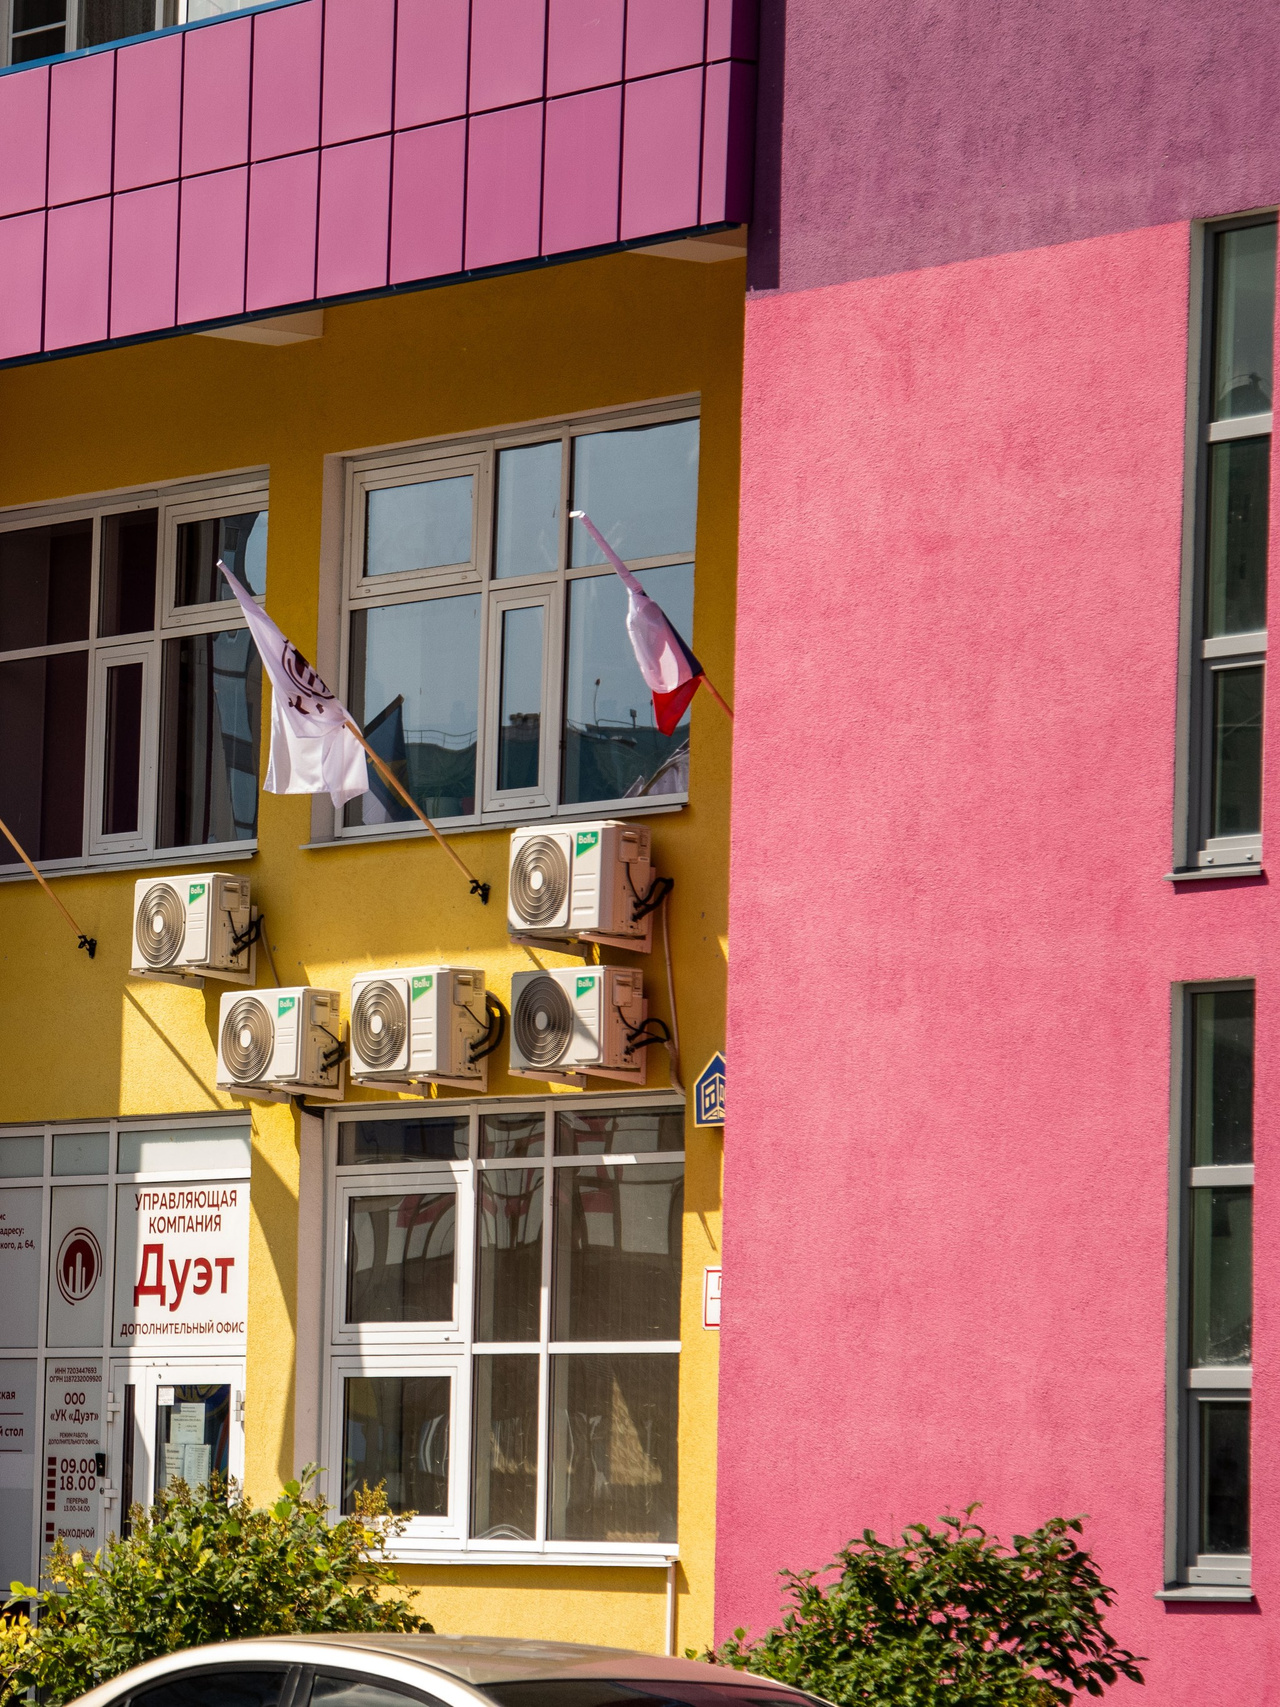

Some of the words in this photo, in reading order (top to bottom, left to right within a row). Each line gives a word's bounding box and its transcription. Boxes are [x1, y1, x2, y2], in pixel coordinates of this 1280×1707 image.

[578, 833, 596, 844] Ballu
[135, 1189, 237, 1211] УПРАВЛЯЮЩАЯ
[148, 1214, 222, 1234] КОМПАНИЯ
[0, 1227, 25, 1237] адресу:
[17, 1241, 24, 1250] д.
[24, 1239, 36, 1250] 64,
[133, 1243, 235, 1312] Дуэт
[120, 1320, 214, 1338] ДОПОЛНИТЕЛЬНЫЙ
[216, 1321, 245, 1334] ОФИС
[54, 1367, 67, 1375] ИНН
[49, 1375, 63, 1383] ОГРН
[64, 1392, 86, 1405] ООО
[50, 1409, 67, 1422] «УК
[68, 1409, 99, 1425] «Дуэт»
[4, 1428, 24, 1437] стол
[60, 1458, 96, 1474] 09.00
[60, 1475, 96, 1491] 18.00
[66, 1497, 88, 1505] ПЕРЕРЫВ
[57, 1527, 95, 1539] ВЫХОДНОЙ
